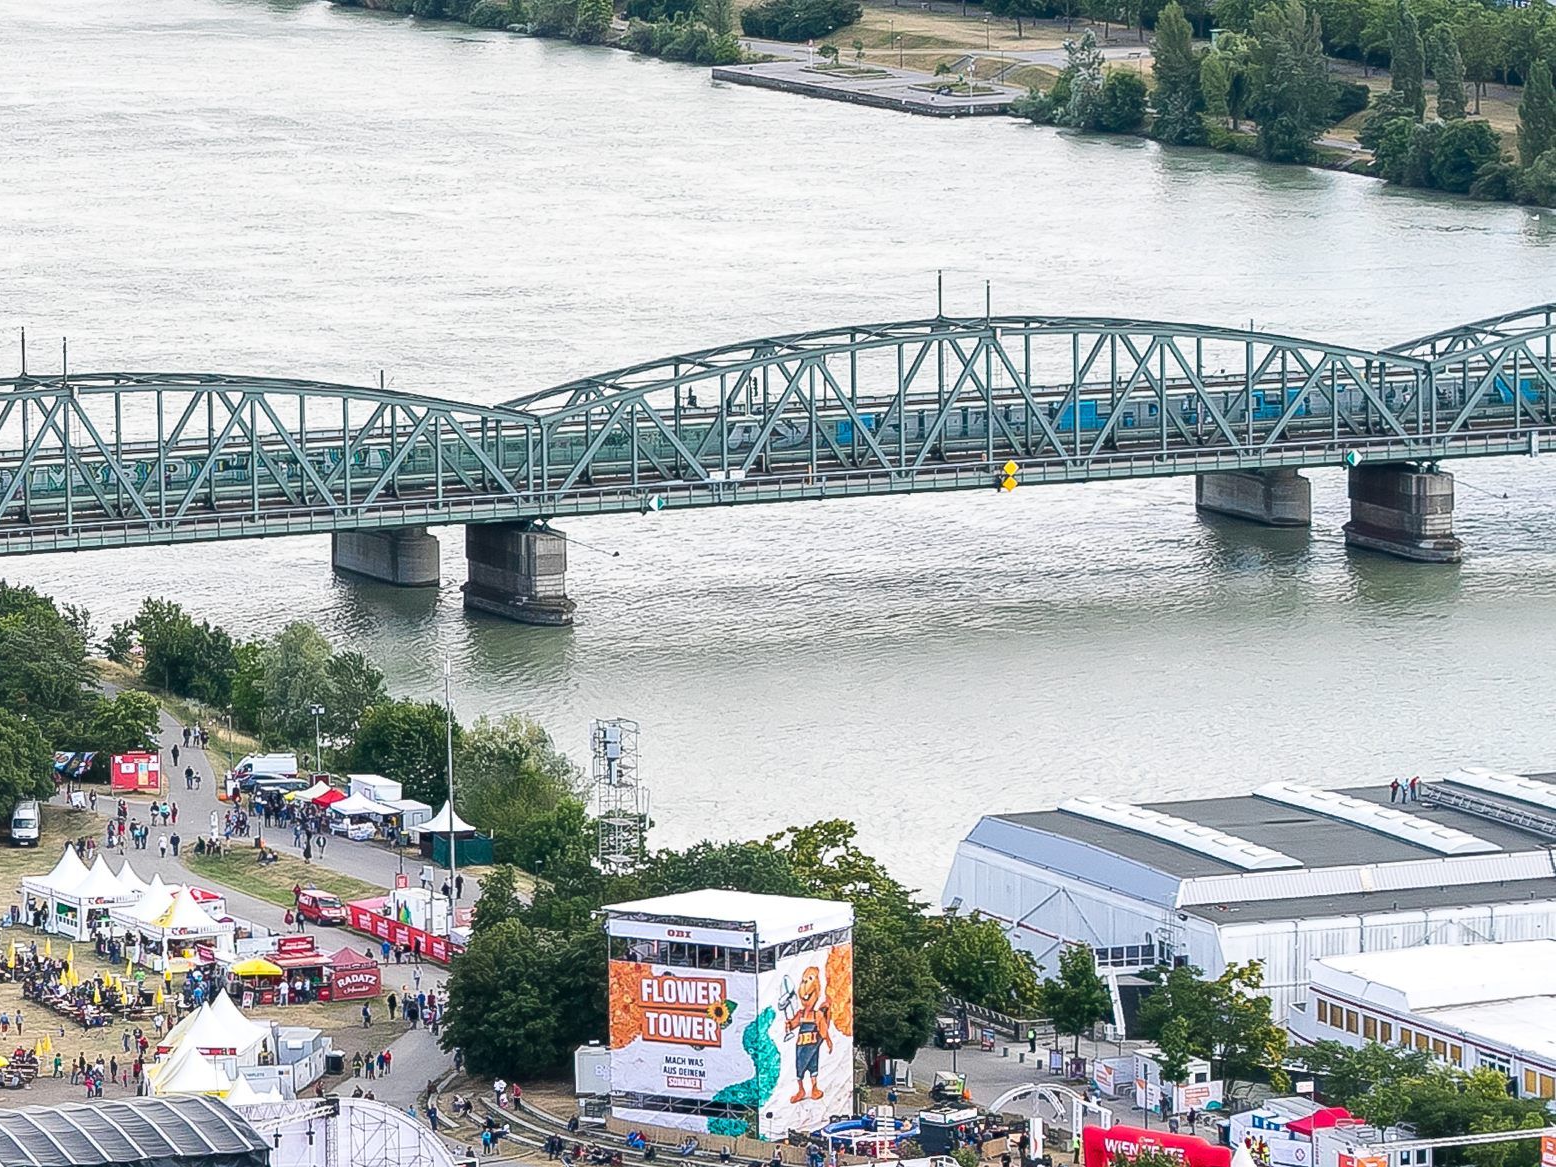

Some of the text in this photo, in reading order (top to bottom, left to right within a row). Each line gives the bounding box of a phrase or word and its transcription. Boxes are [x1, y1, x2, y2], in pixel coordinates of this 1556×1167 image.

[667, 929, 692, 939] OBI
[337, 973, 377, 988] RADATZ
[641, 978, 722, 1006] FLOWER
[645, 1012, 718, 1042] TOWER
[664, 1056, 704, 1067] MACH WAS
[663, 1066, 706, 1077] AUS DEINEM
[668, 1078, 701, 1089] SOMMER
